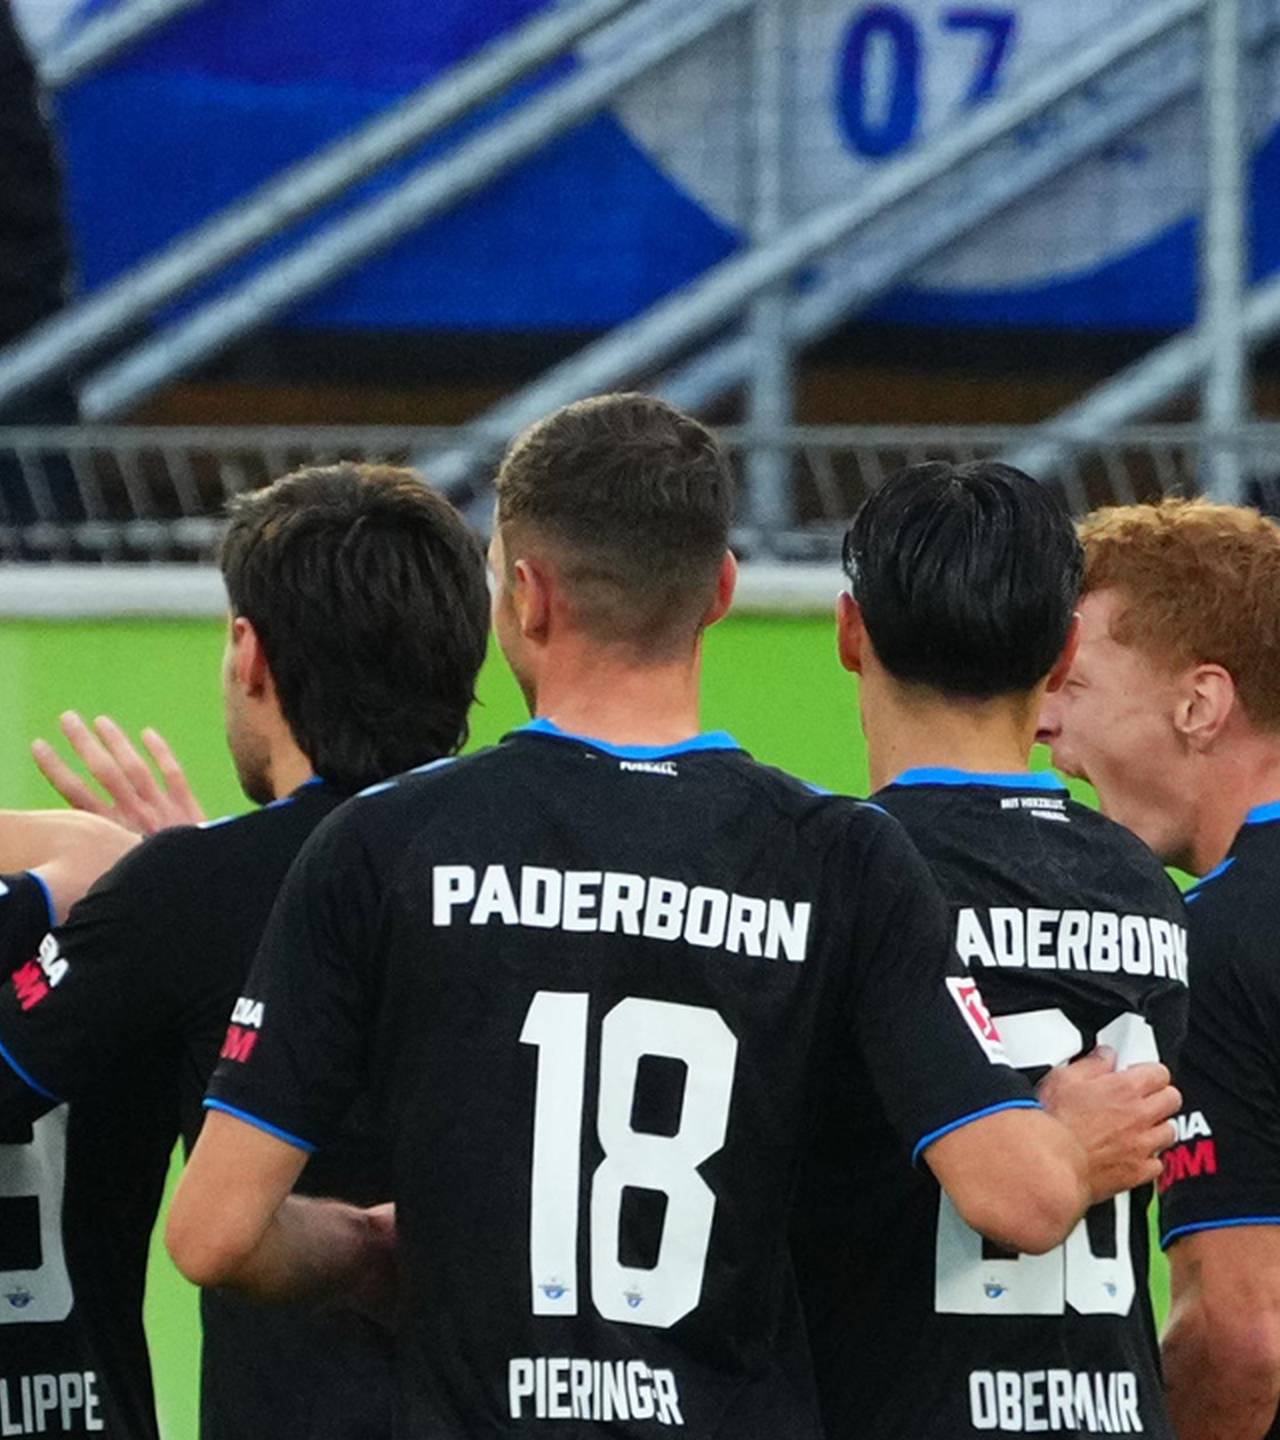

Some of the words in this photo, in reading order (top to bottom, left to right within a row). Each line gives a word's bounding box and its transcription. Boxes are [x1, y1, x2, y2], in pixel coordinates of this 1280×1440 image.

[431, 864, 812, 962] PADERBORN
[955, 907, 1190, 989] ADERBORN
[518, 990, 739, 1328] 18
[968, 1368, 1145, 1434] OBERMAIR
